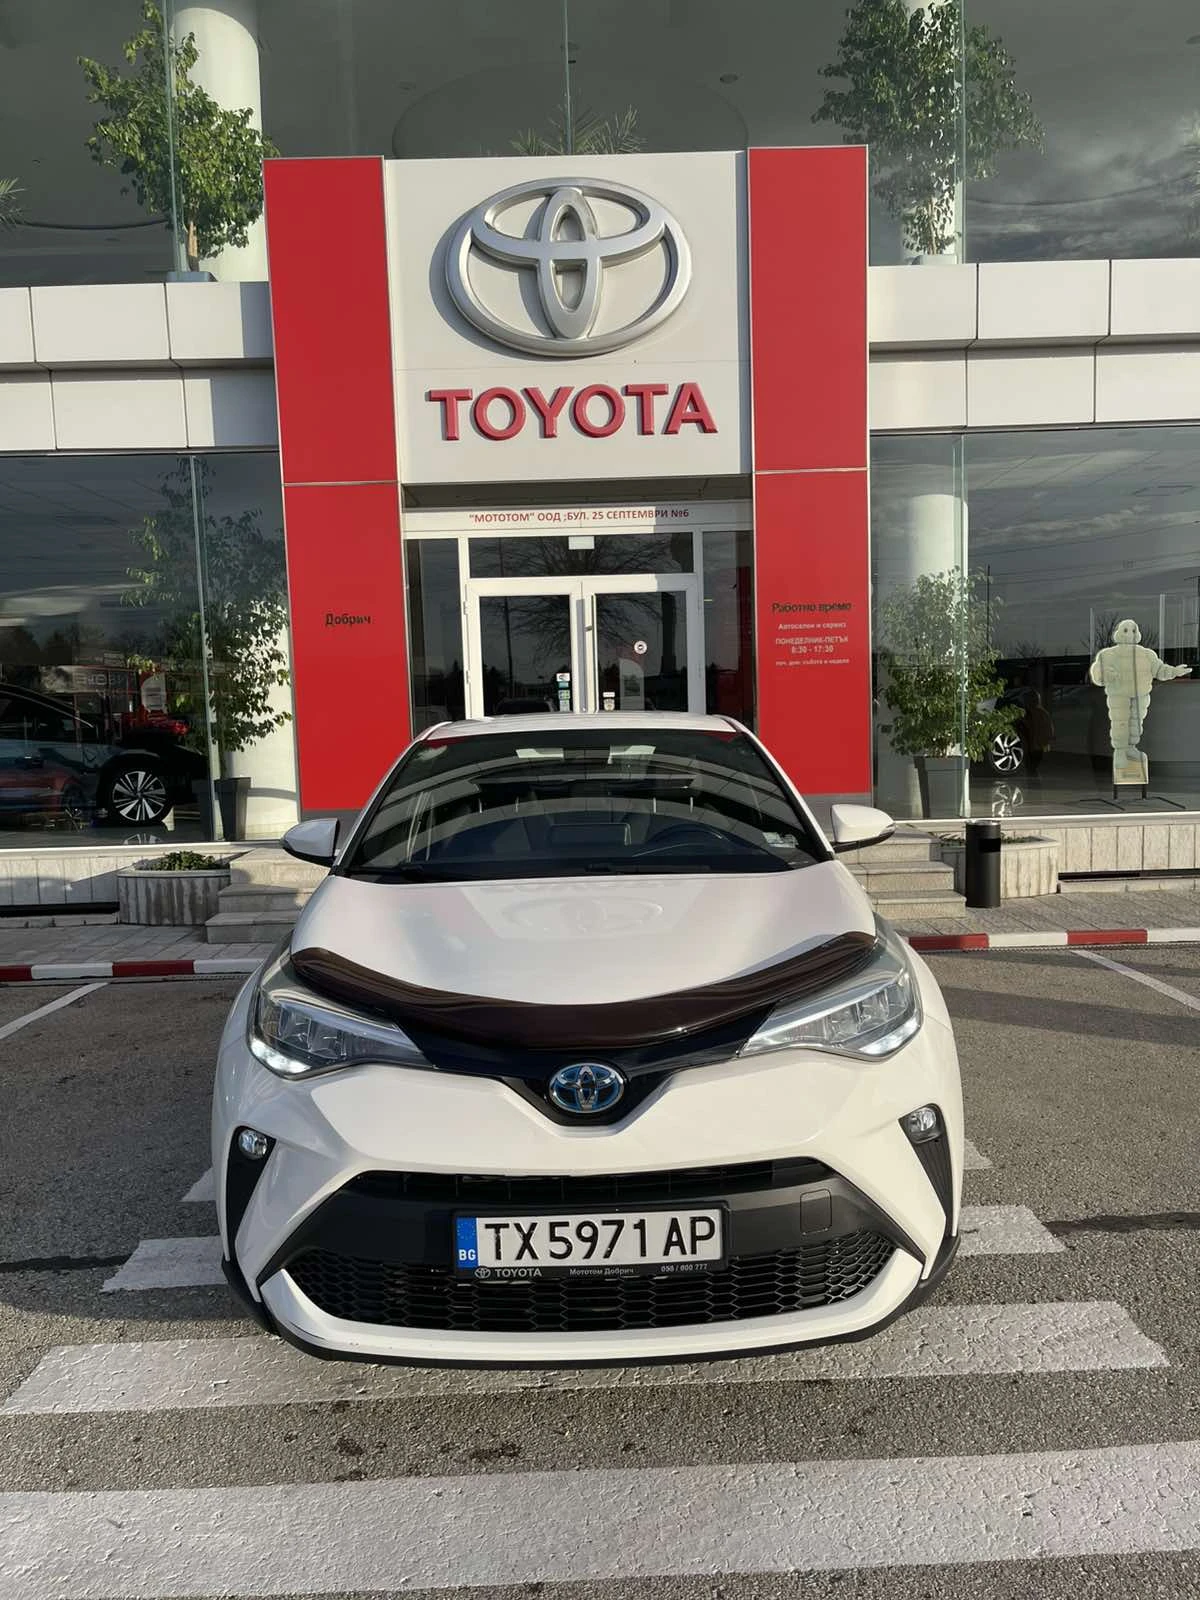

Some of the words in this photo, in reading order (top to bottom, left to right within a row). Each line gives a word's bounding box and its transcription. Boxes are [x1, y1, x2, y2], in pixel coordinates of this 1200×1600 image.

[426, 382, 718, 441] TOYOTA
[537, 512, 561, 522] ООД
[592, 511, 604, 520] 25
[606, 509, 668, 520] СЕПТЕМВРИ
[671, 508, 689, 518] №6
[772, 602, 816, 614] Работно
[818, 602, 852, 613] време
[325, 613, 371, 628] Добрич
[458, 1249, 477, 1261] BG
[484, 1222, 540, 1261] TX
[548, 1218, 647, 1260] 5971
[662, 1216, 716, 1257] AP
[494, 1268, 542, 1277] TOYOTA
[569, 1267, 603, 1276] Мототом
[604, 1267, 634, 1276] Добрич
